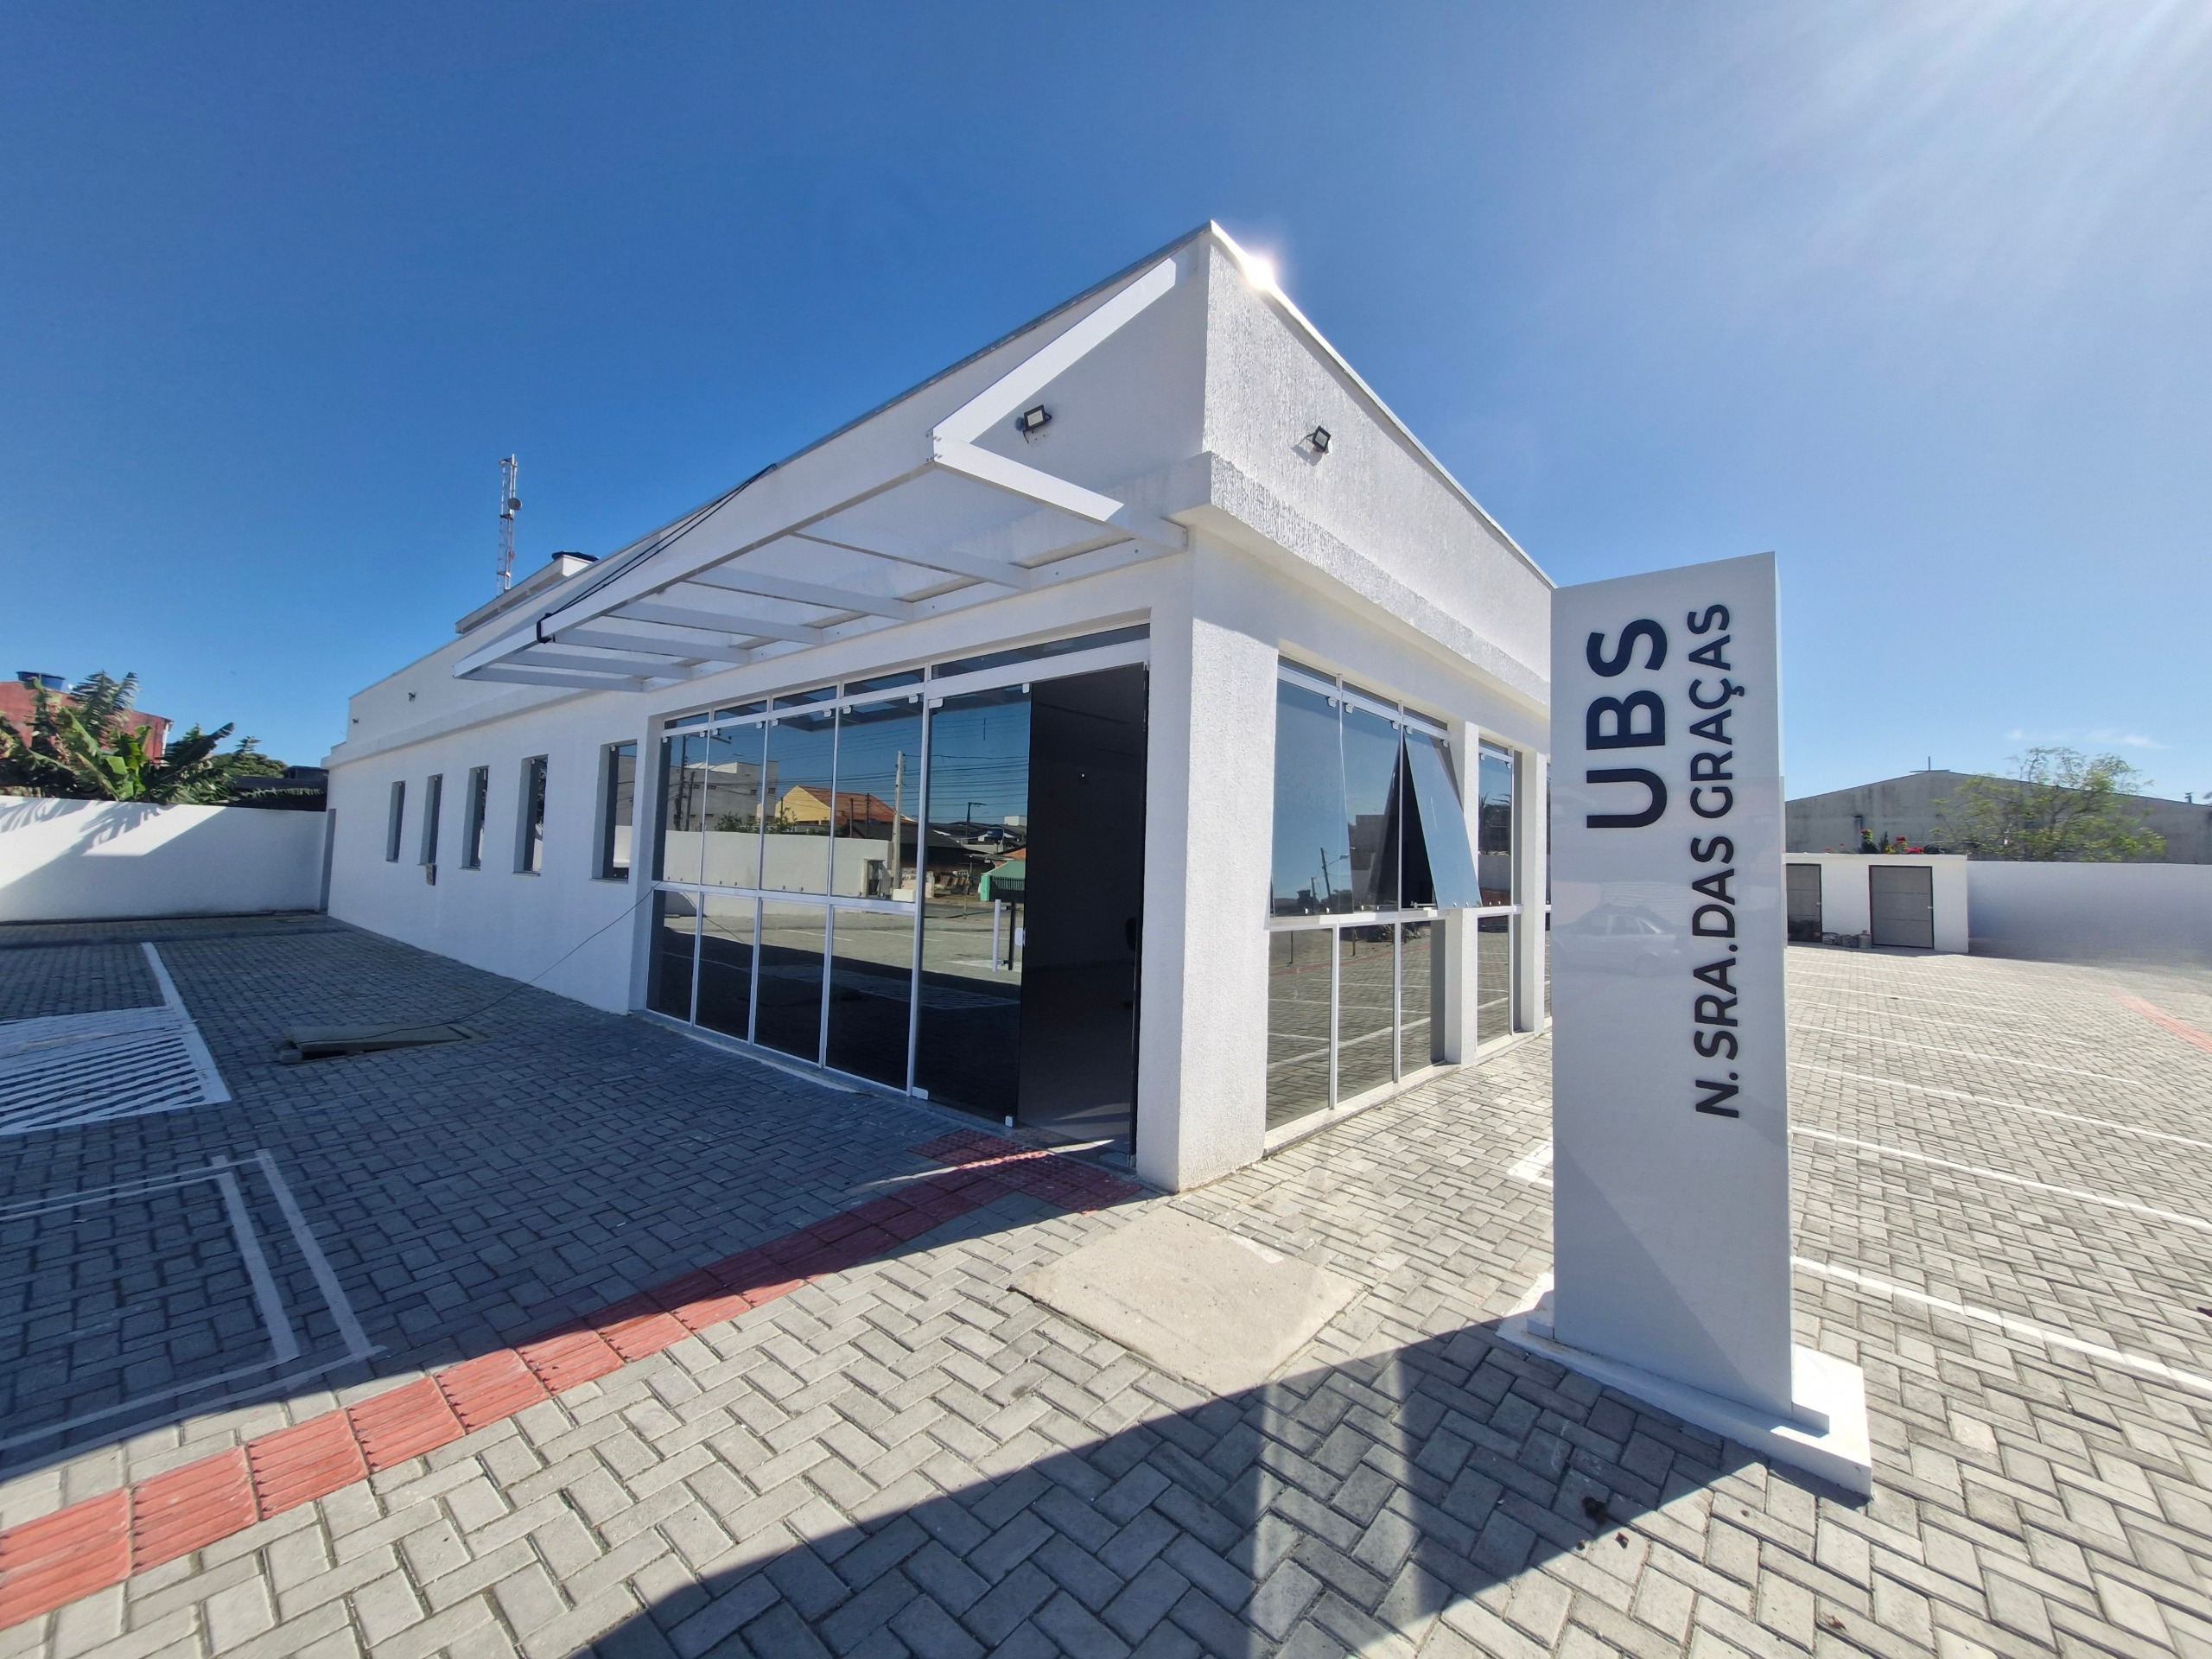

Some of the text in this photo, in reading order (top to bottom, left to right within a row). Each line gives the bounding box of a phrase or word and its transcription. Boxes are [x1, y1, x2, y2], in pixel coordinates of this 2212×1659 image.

[1585, 617, 1669, 830] UBS
[1686, 603, 1745, 819] GRAÇAS
[1694, 1071, 1741, 1119] N.
